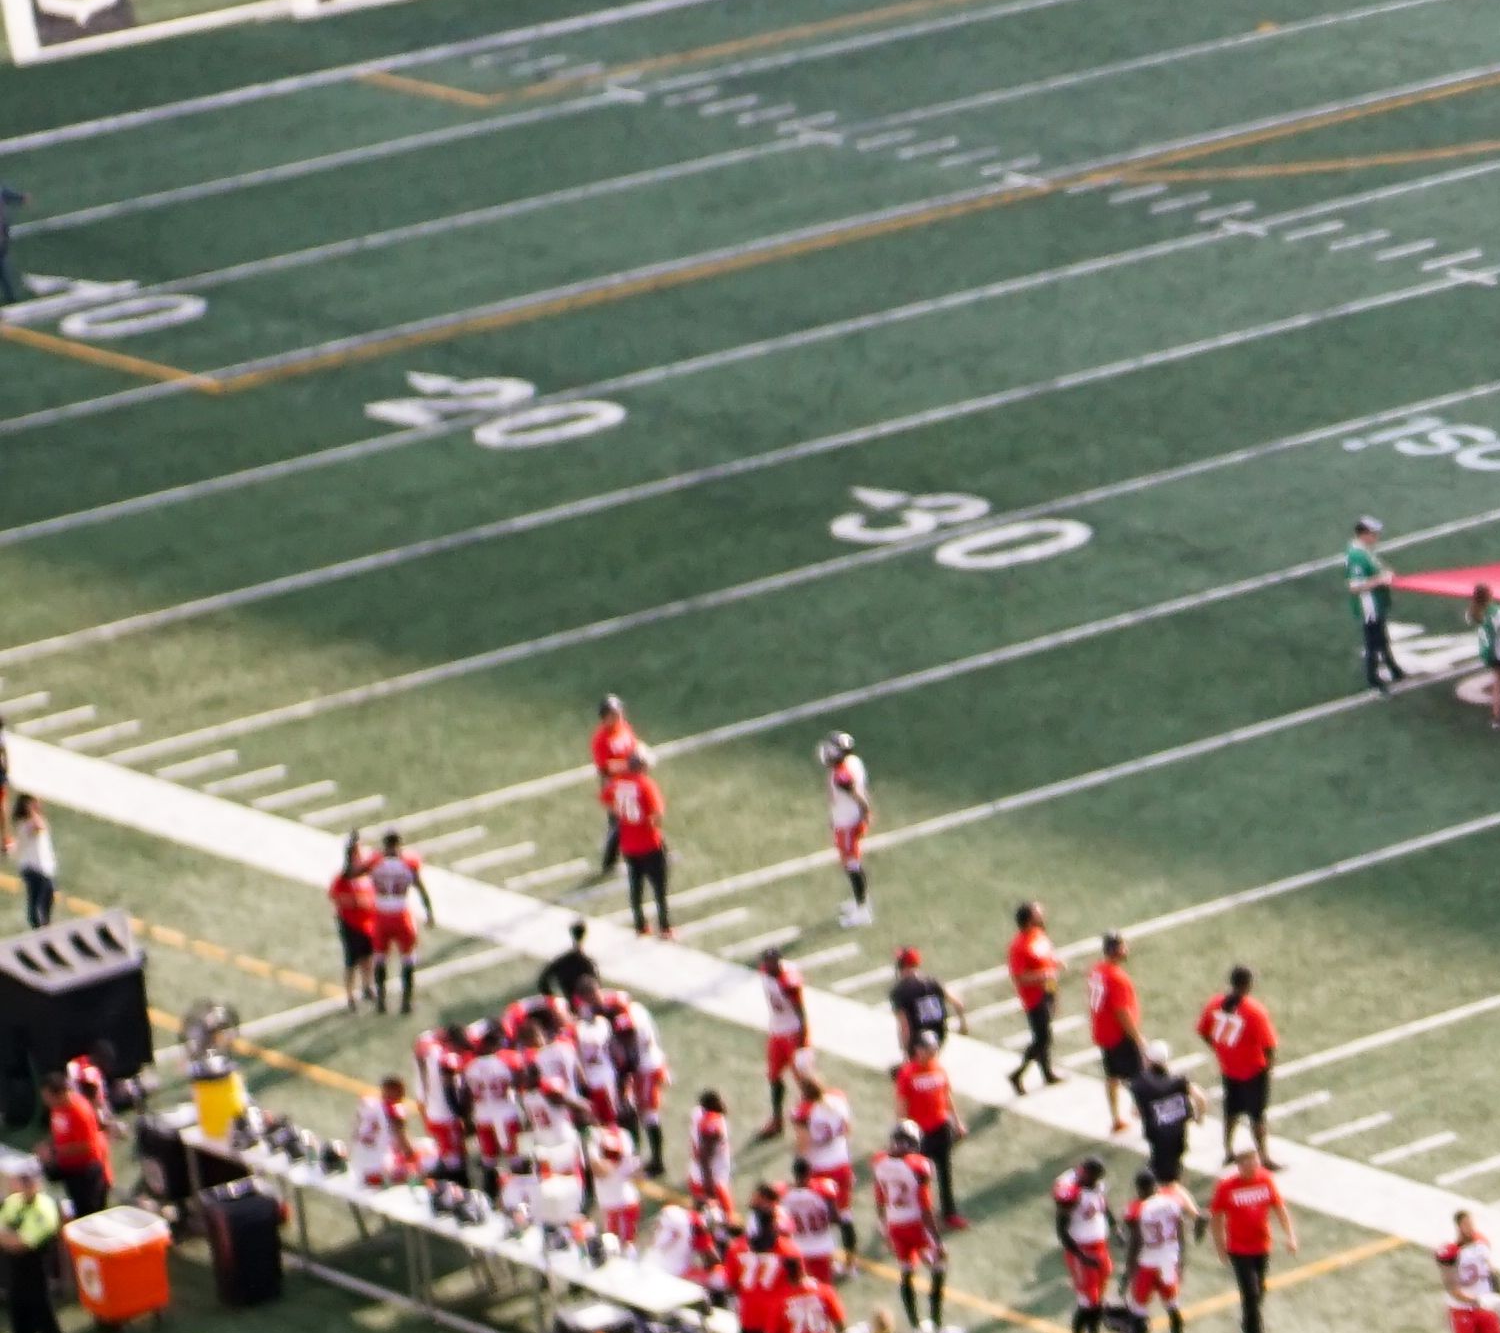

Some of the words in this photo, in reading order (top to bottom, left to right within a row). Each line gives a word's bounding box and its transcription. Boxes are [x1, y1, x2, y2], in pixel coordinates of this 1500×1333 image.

[830, 489, 1094, 572] 30
[1213, 1011, 1244, 1047] 77
[78, 1255, 99, 1298] G
[737, 1252, 780, 1290] 77
